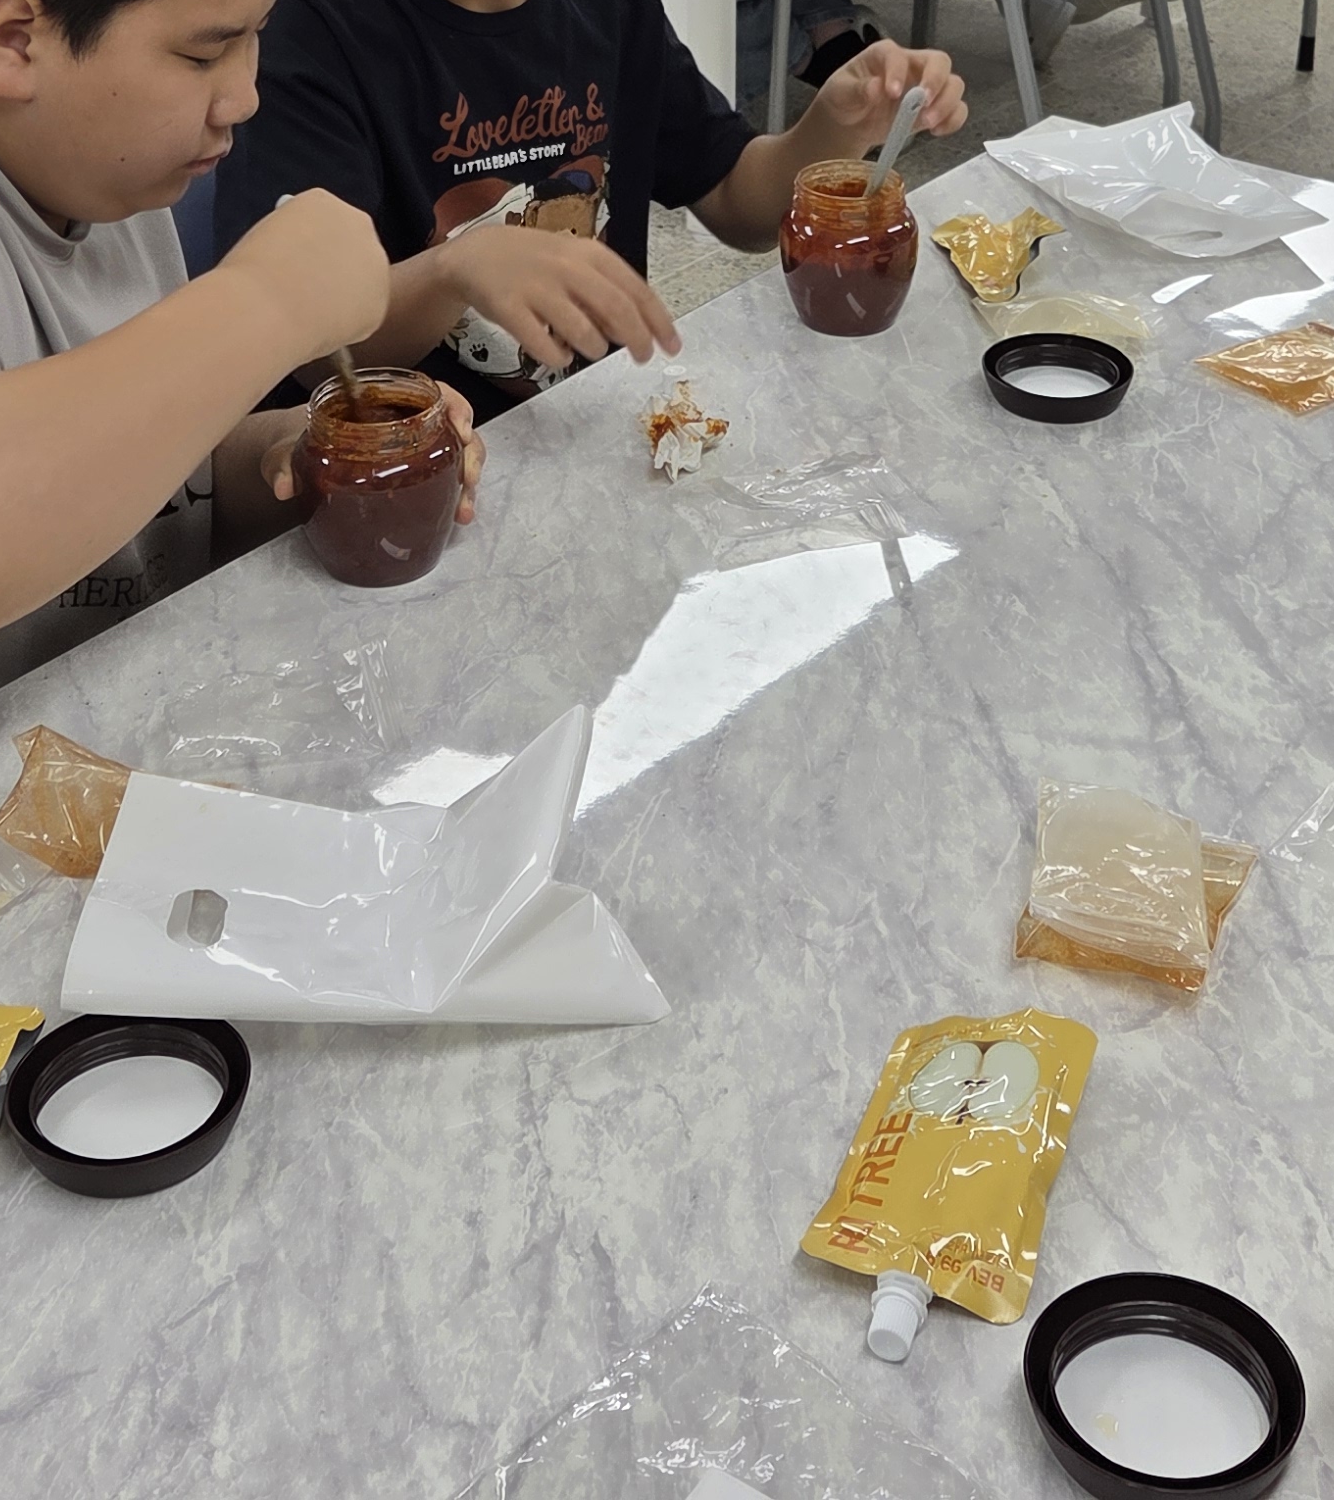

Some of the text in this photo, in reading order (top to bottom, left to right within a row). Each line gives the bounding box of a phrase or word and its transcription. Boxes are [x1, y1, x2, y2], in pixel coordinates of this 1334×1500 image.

[432, 82, 605, 162] Loveletter &
[529, 142, 566, 160] STORY
[848, 1112, 913, 1207] TREE
[966, 1264, 1005, 1293] BEV
